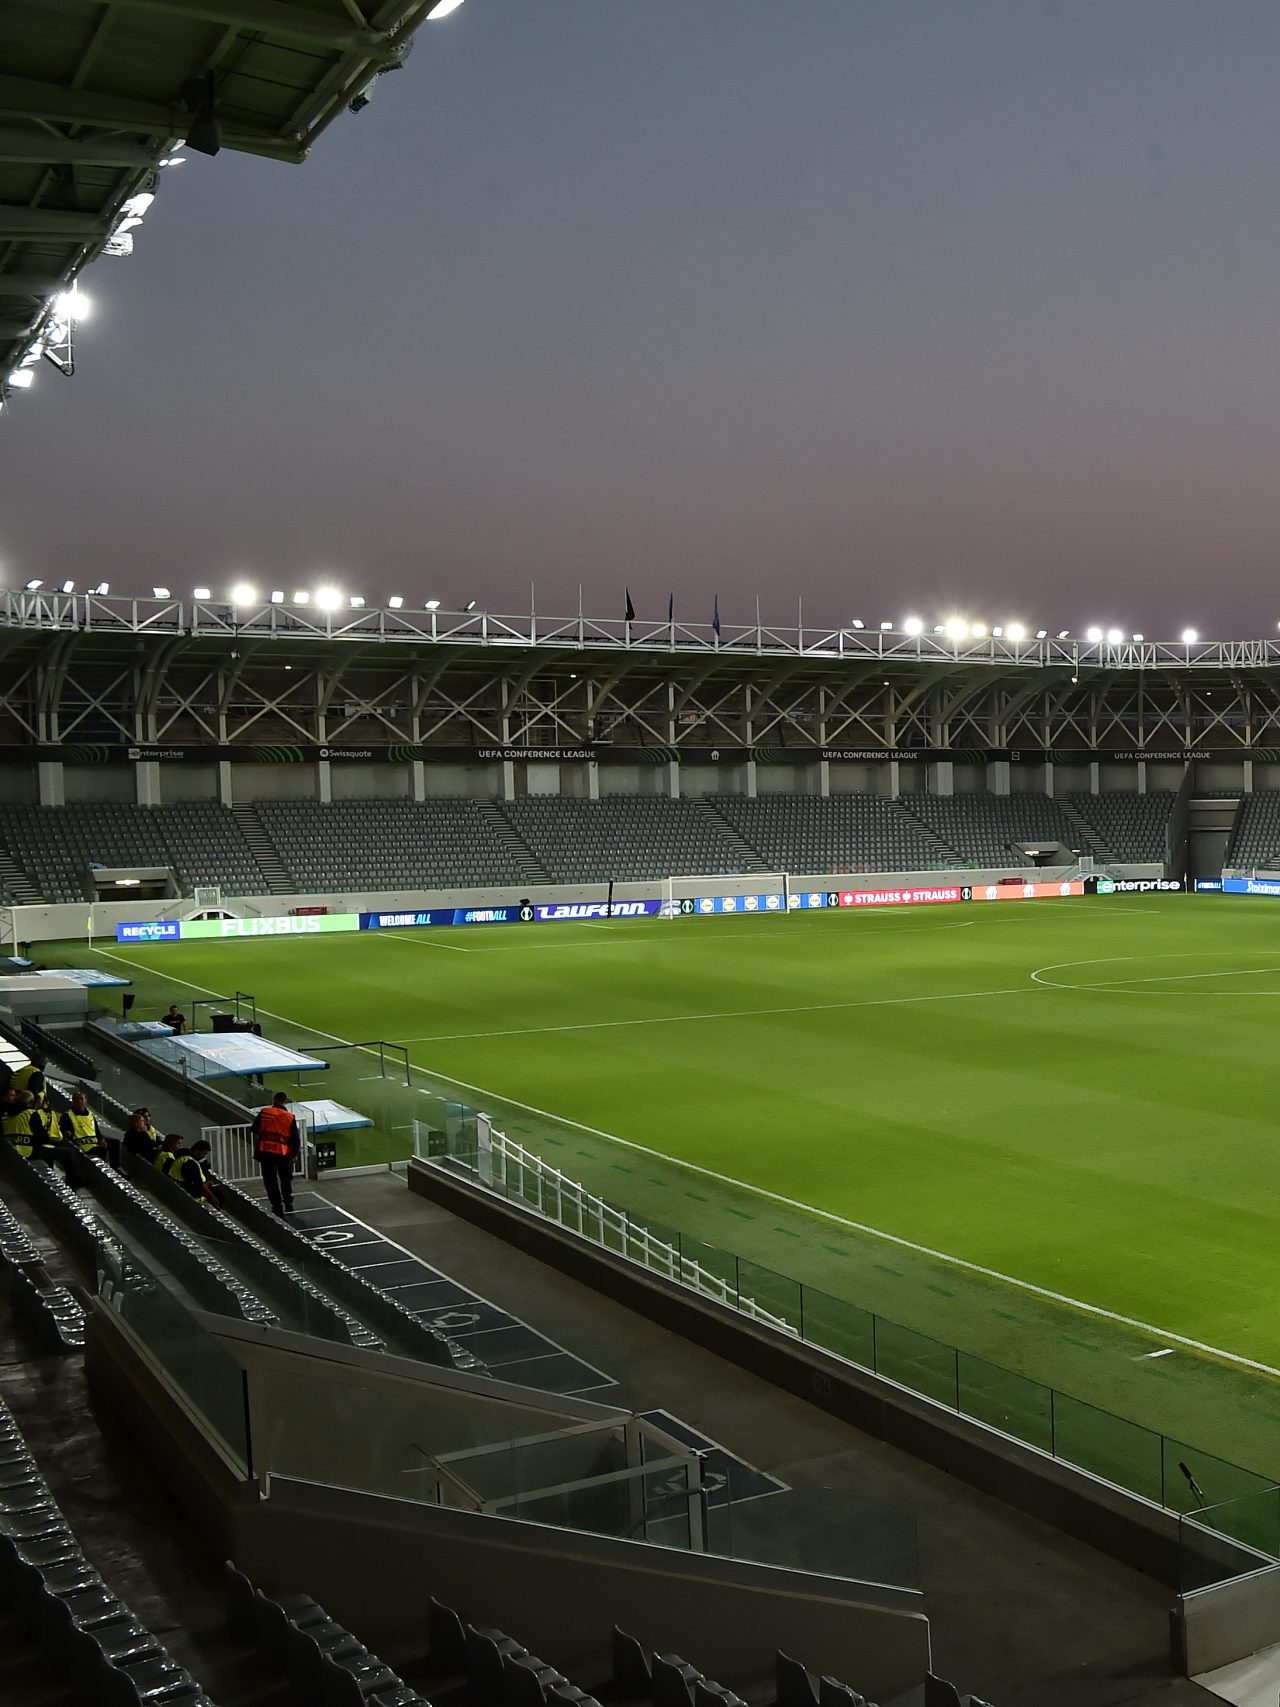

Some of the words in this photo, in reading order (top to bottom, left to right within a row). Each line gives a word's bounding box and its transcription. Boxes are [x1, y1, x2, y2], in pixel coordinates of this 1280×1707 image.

[329, 749, 372, 759] Swissquote
[478, 750, 502, 758] UEFA
[504, 750, 561, 758] CONFERENCE
[563, 750, 596, 758] LEAGUE
[822, 751, 842, 759] UEFA
[843, 751, 889, 759] CONFERENCE
[891, 751, 918, 759] LEAGUE
[1102, 879, 1180, 892] enterprise
[854, 891, 900, 904] STRAUSS
[912, 889, 957, 901] STRAUSS
[416, 913, 431, 925] ALL
[122, 925, 176, 937] RECYCLE
